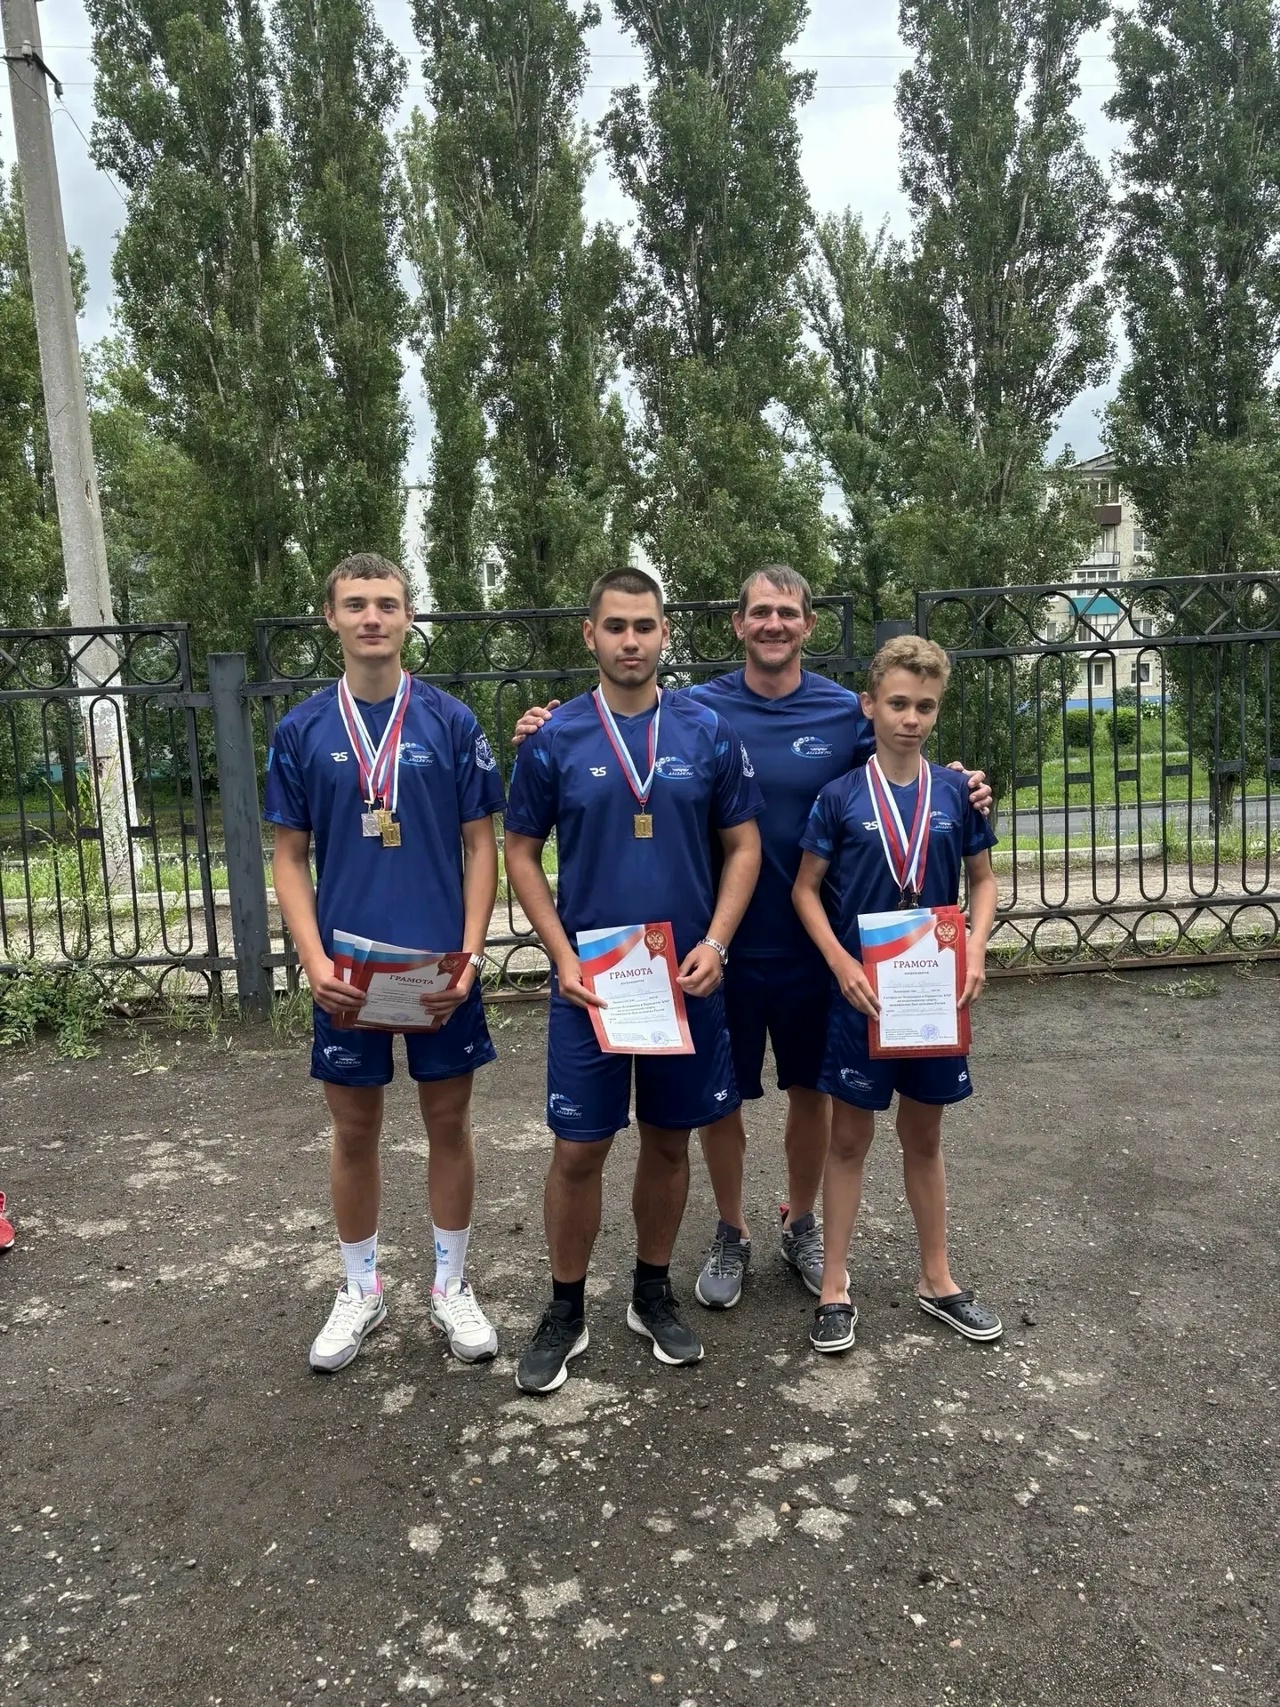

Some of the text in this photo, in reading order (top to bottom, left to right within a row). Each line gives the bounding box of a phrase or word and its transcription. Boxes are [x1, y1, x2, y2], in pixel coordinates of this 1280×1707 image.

[330, 751, 349, 762] RS
[589, 766, 607, 777] RS
[893, 960, 939, 969] ГРАМОТА
[609, 967, 653, 980] ГРАМОТА
[389, 974, 434, 985] ГРАМОТА
